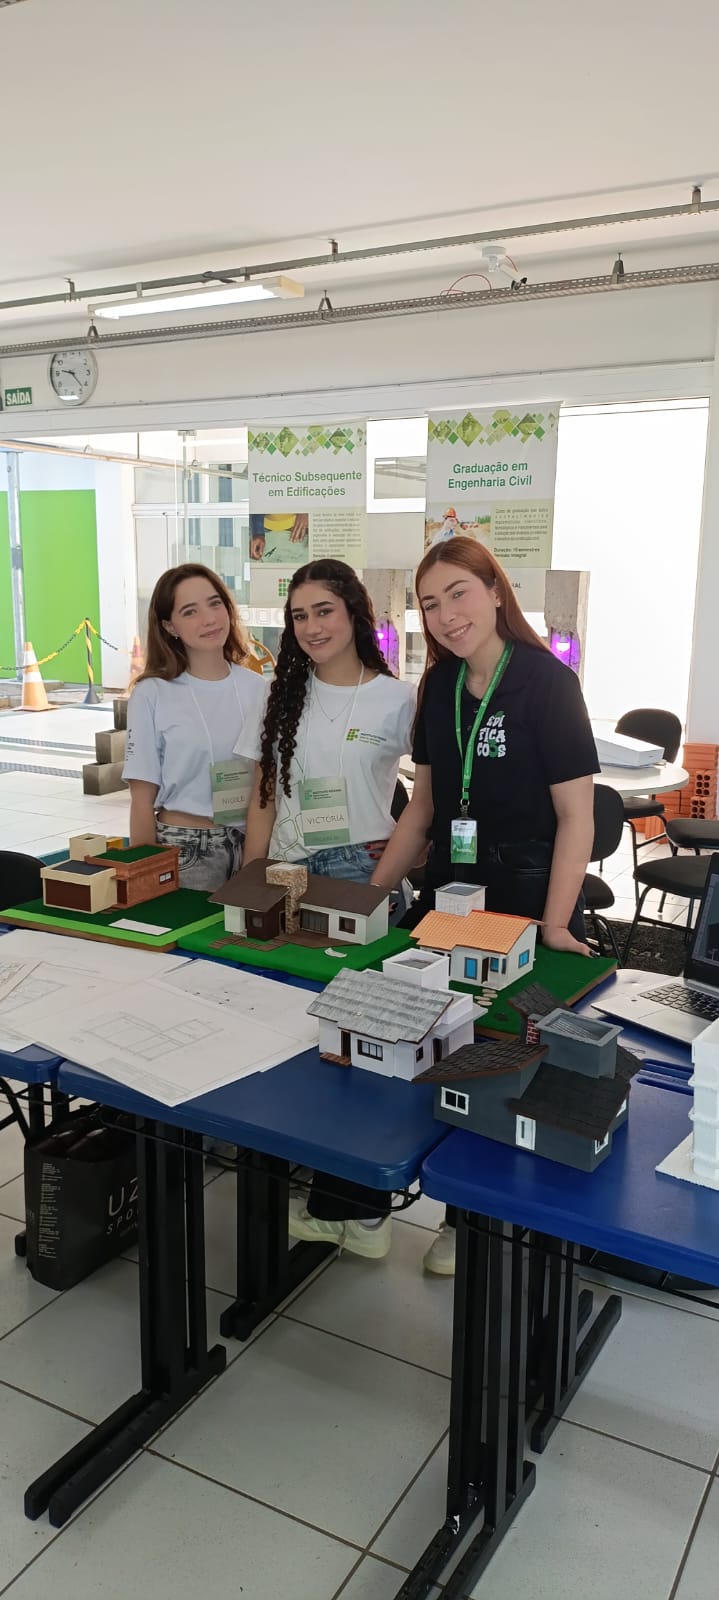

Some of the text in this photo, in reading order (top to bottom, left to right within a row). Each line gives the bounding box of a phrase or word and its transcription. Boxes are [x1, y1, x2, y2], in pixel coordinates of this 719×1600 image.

[6, 389, 31, 405] SAÍDA
[453, 461, 528, 475] Graduação em
[252, 470, 362, 483] Técnico Subsequente
[448, 475, 532, 490] Engenharia Civil
[268, 485, 346, 498] em Edificações
[106, 1208, 139, 1235] SPO
